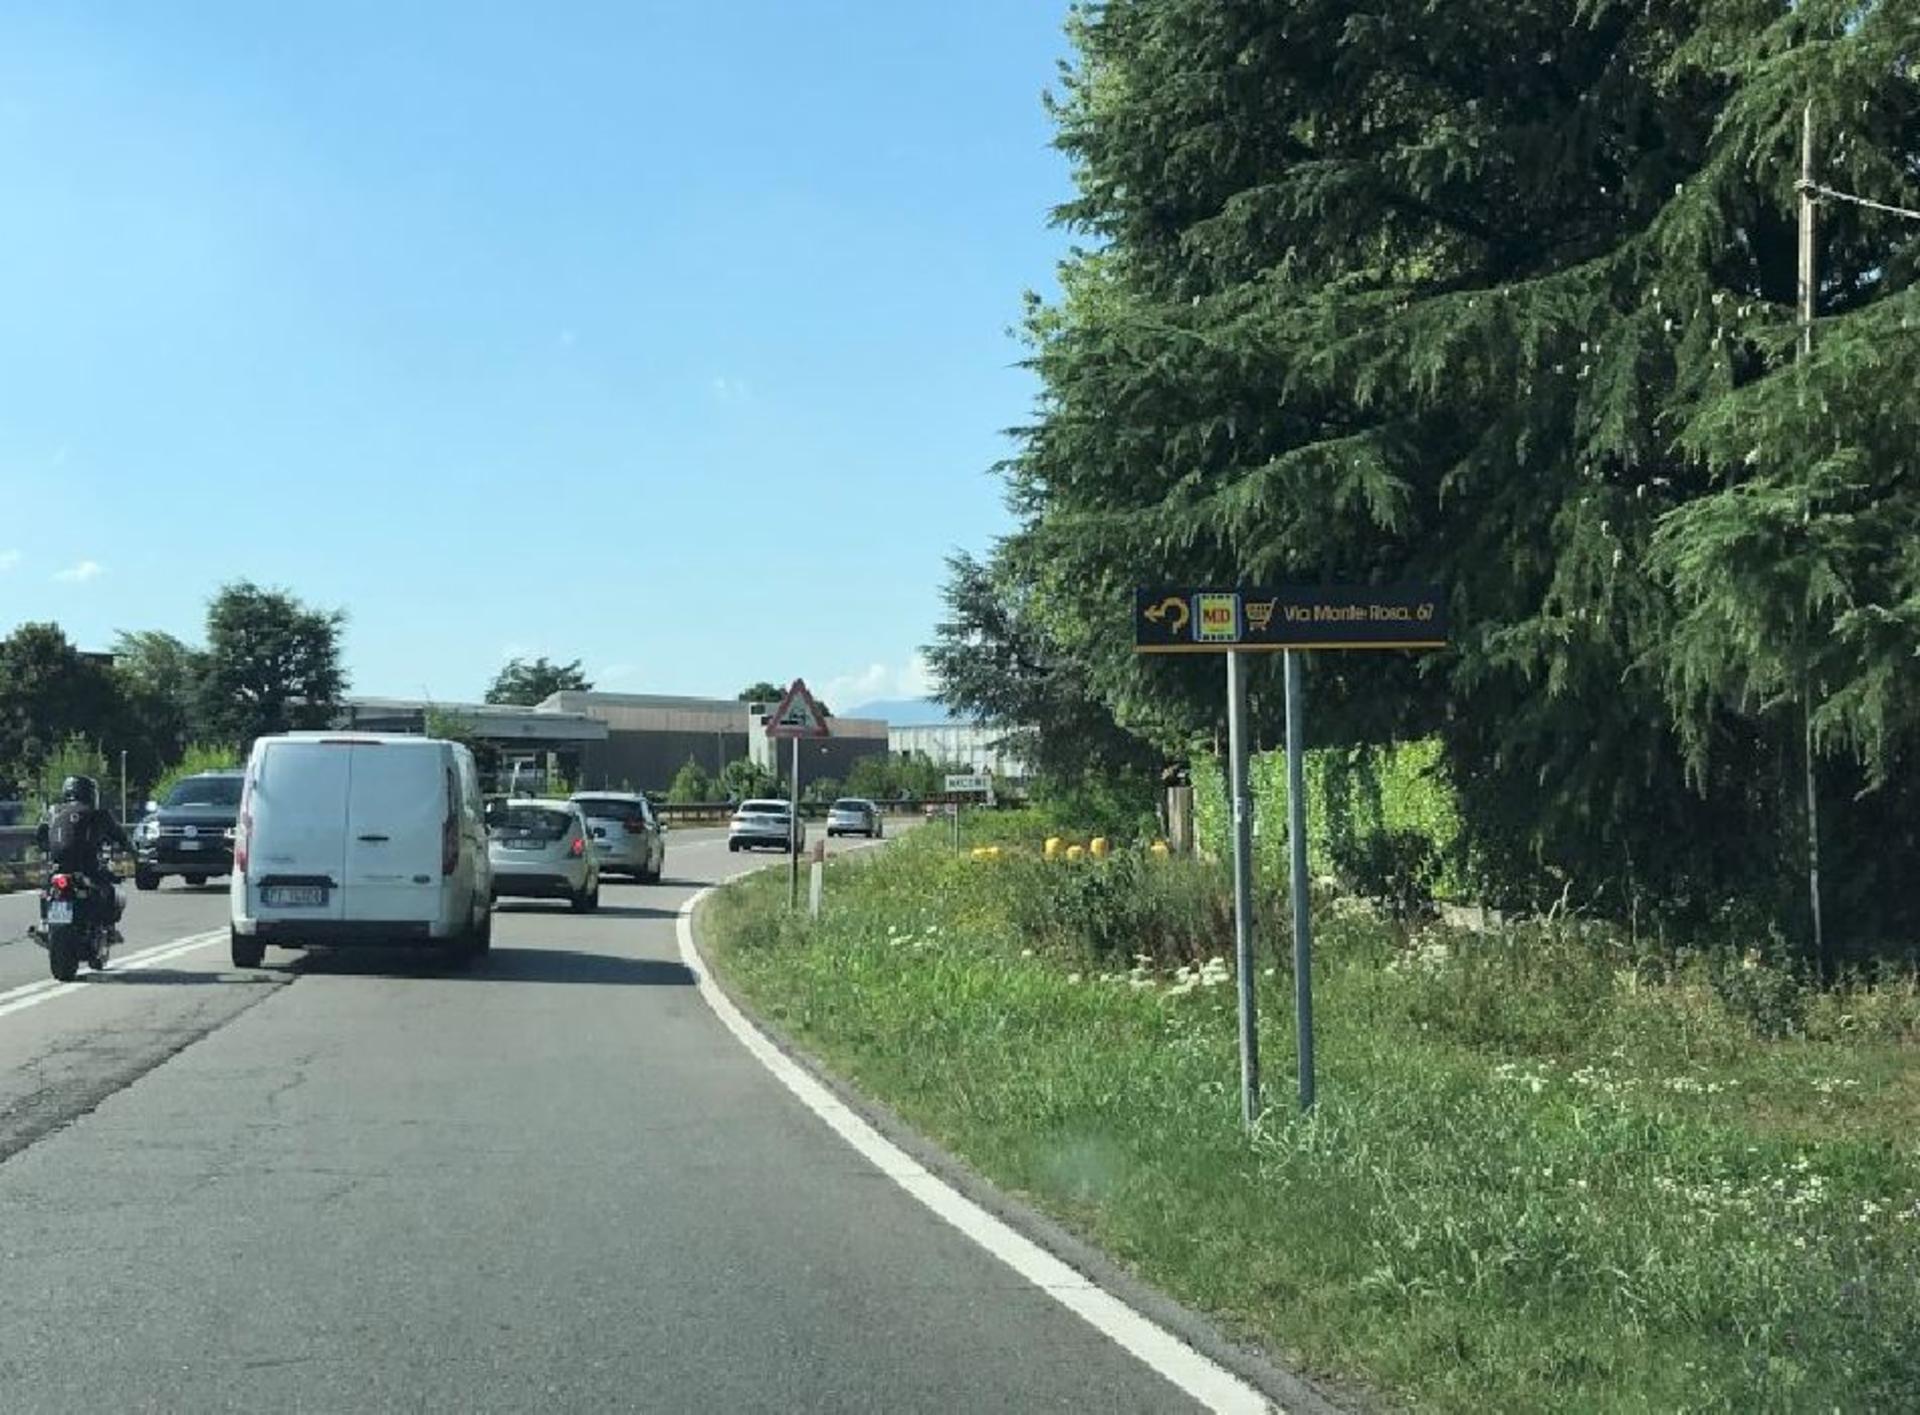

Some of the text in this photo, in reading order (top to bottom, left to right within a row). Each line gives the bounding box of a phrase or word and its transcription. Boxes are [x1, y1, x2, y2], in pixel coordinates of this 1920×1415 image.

[1284, 604, 1310, 621] Via
[1315, 603, 1367, 621] Monte
[1417, 602, 1434, 620] 67
